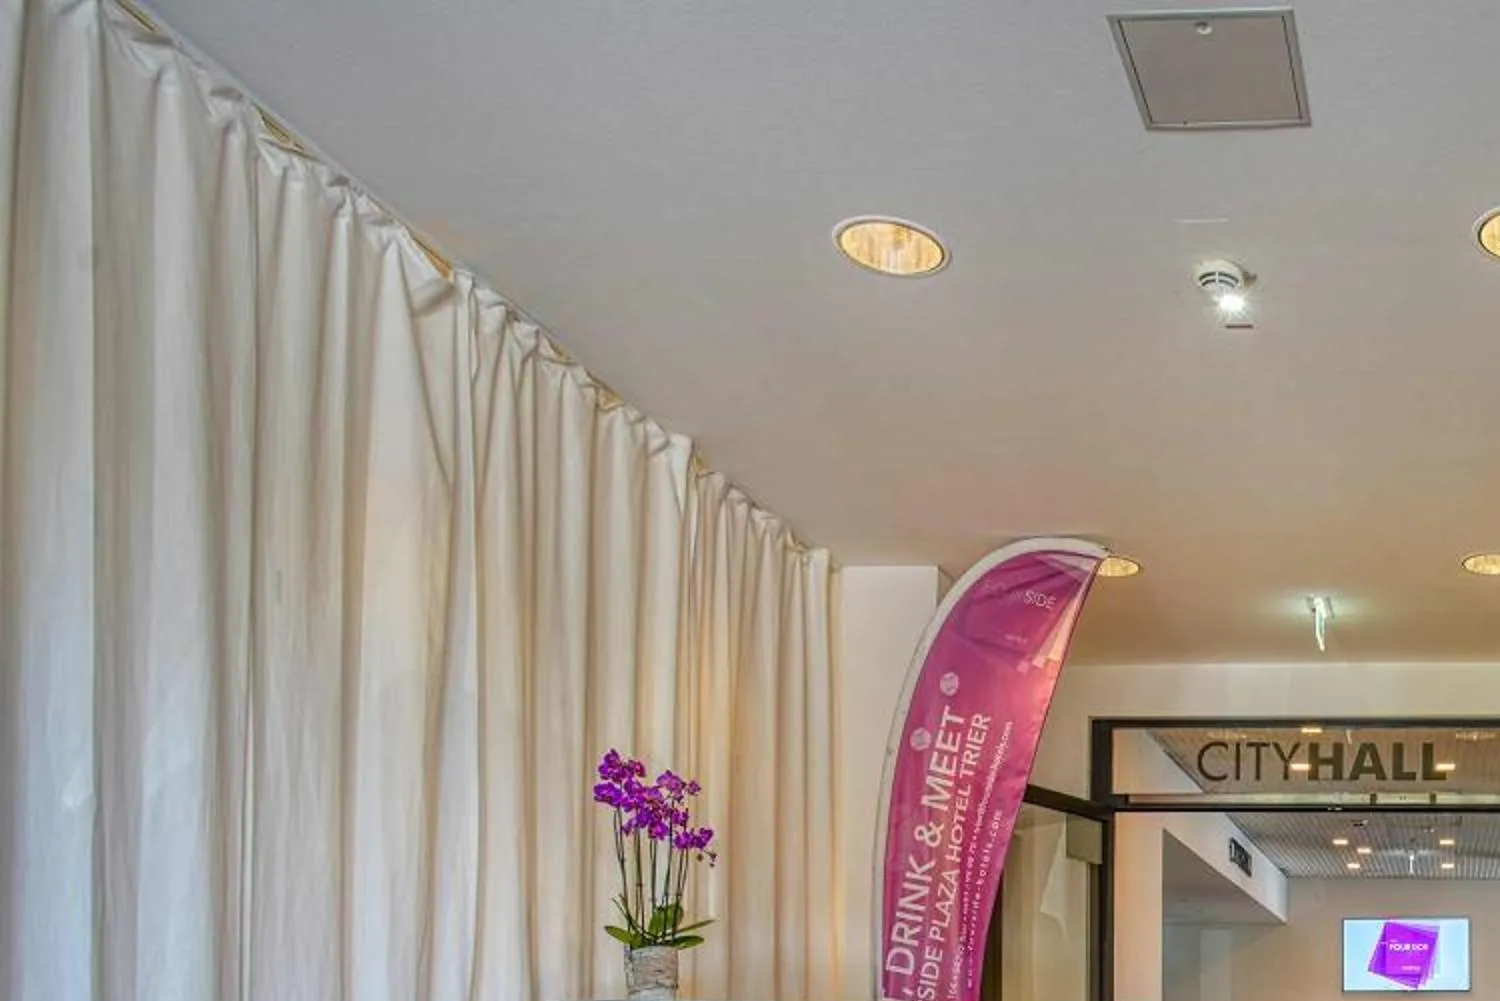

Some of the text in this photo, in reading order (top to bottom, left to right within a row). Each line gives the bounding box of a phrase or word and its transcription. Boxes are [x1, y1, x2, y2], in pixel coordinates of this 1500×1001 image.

[920, 705, 964, 812] MEET
[959, 713, 991, 778] TRIER
[914, 821, 945, 848] &
[944, 783, 972, 862] HOTEL
[885, 853, 936, 976] DRINK
[928, 869, 961, 941] PLAZA
